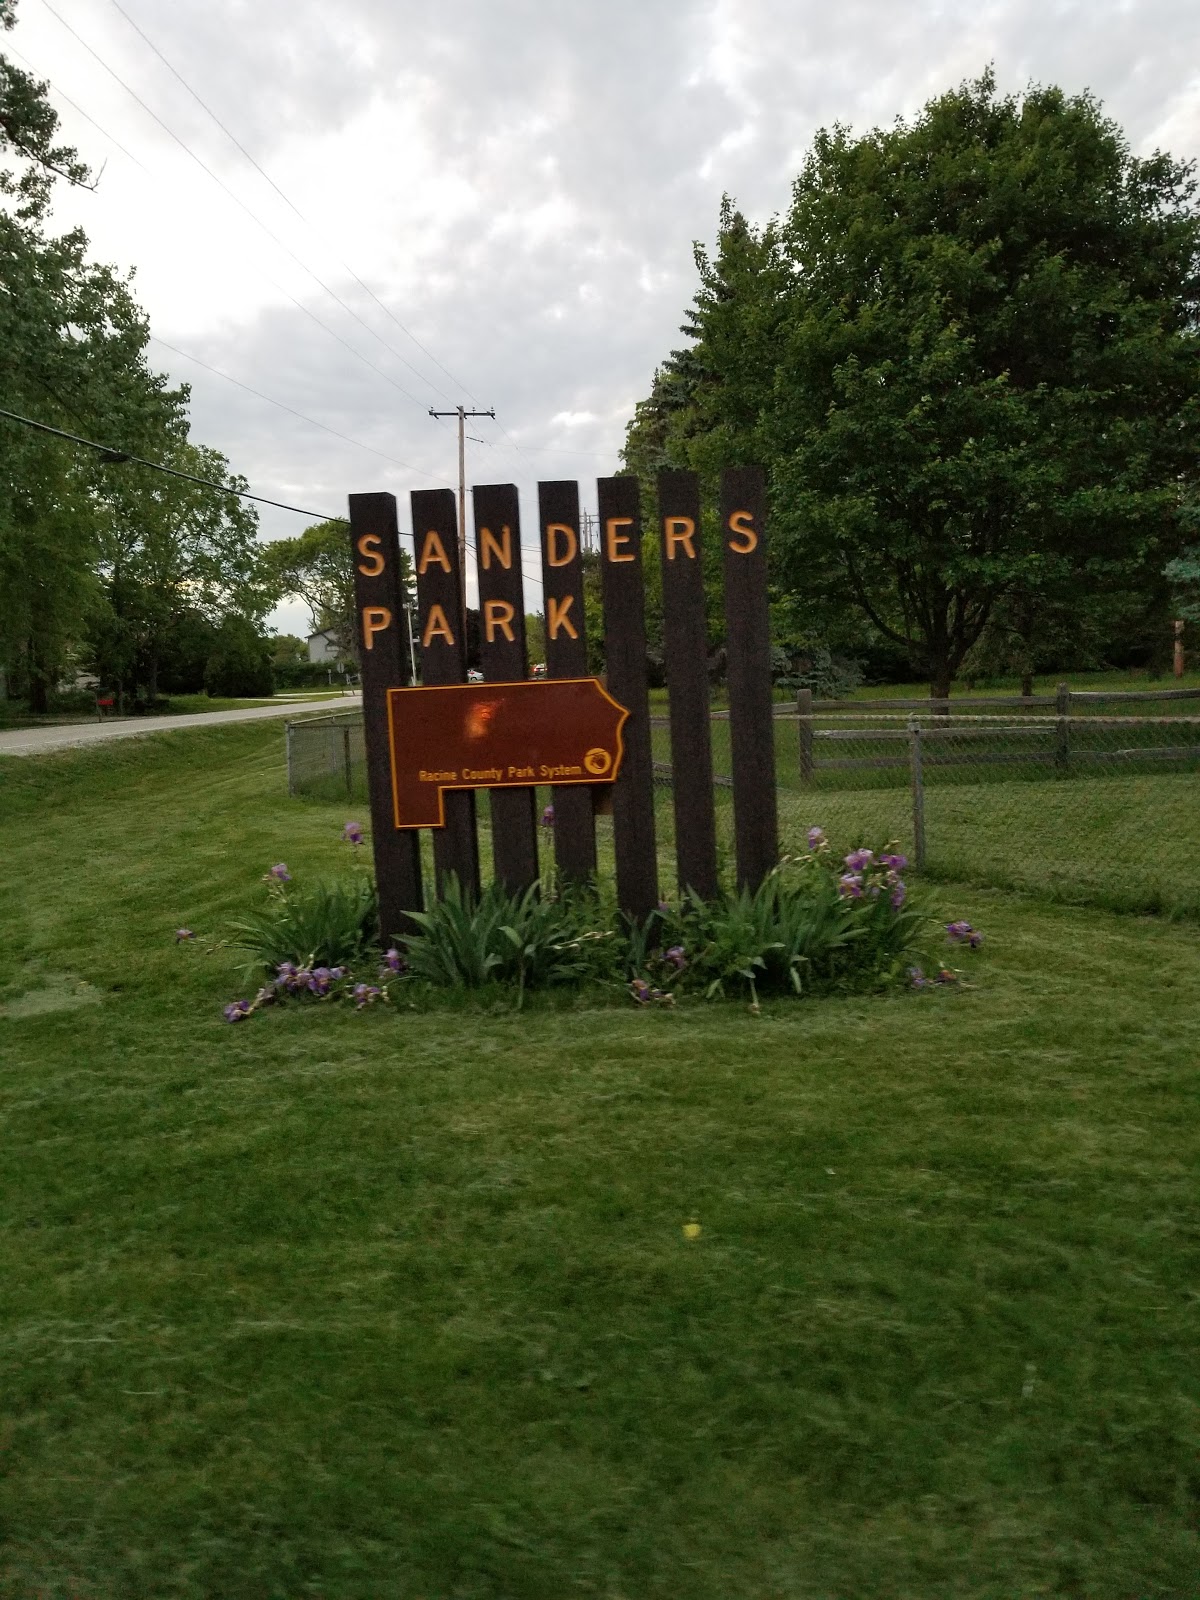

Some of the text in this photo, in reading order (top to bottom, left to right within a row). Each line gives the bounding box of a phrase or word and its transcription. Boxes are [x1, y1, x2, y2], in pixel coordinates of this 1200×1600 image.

[357, 510, 758, 577] SANDERS
[362, 594, 579, 650] PARK
[419, 764, 583, 782] Racine County Park System
